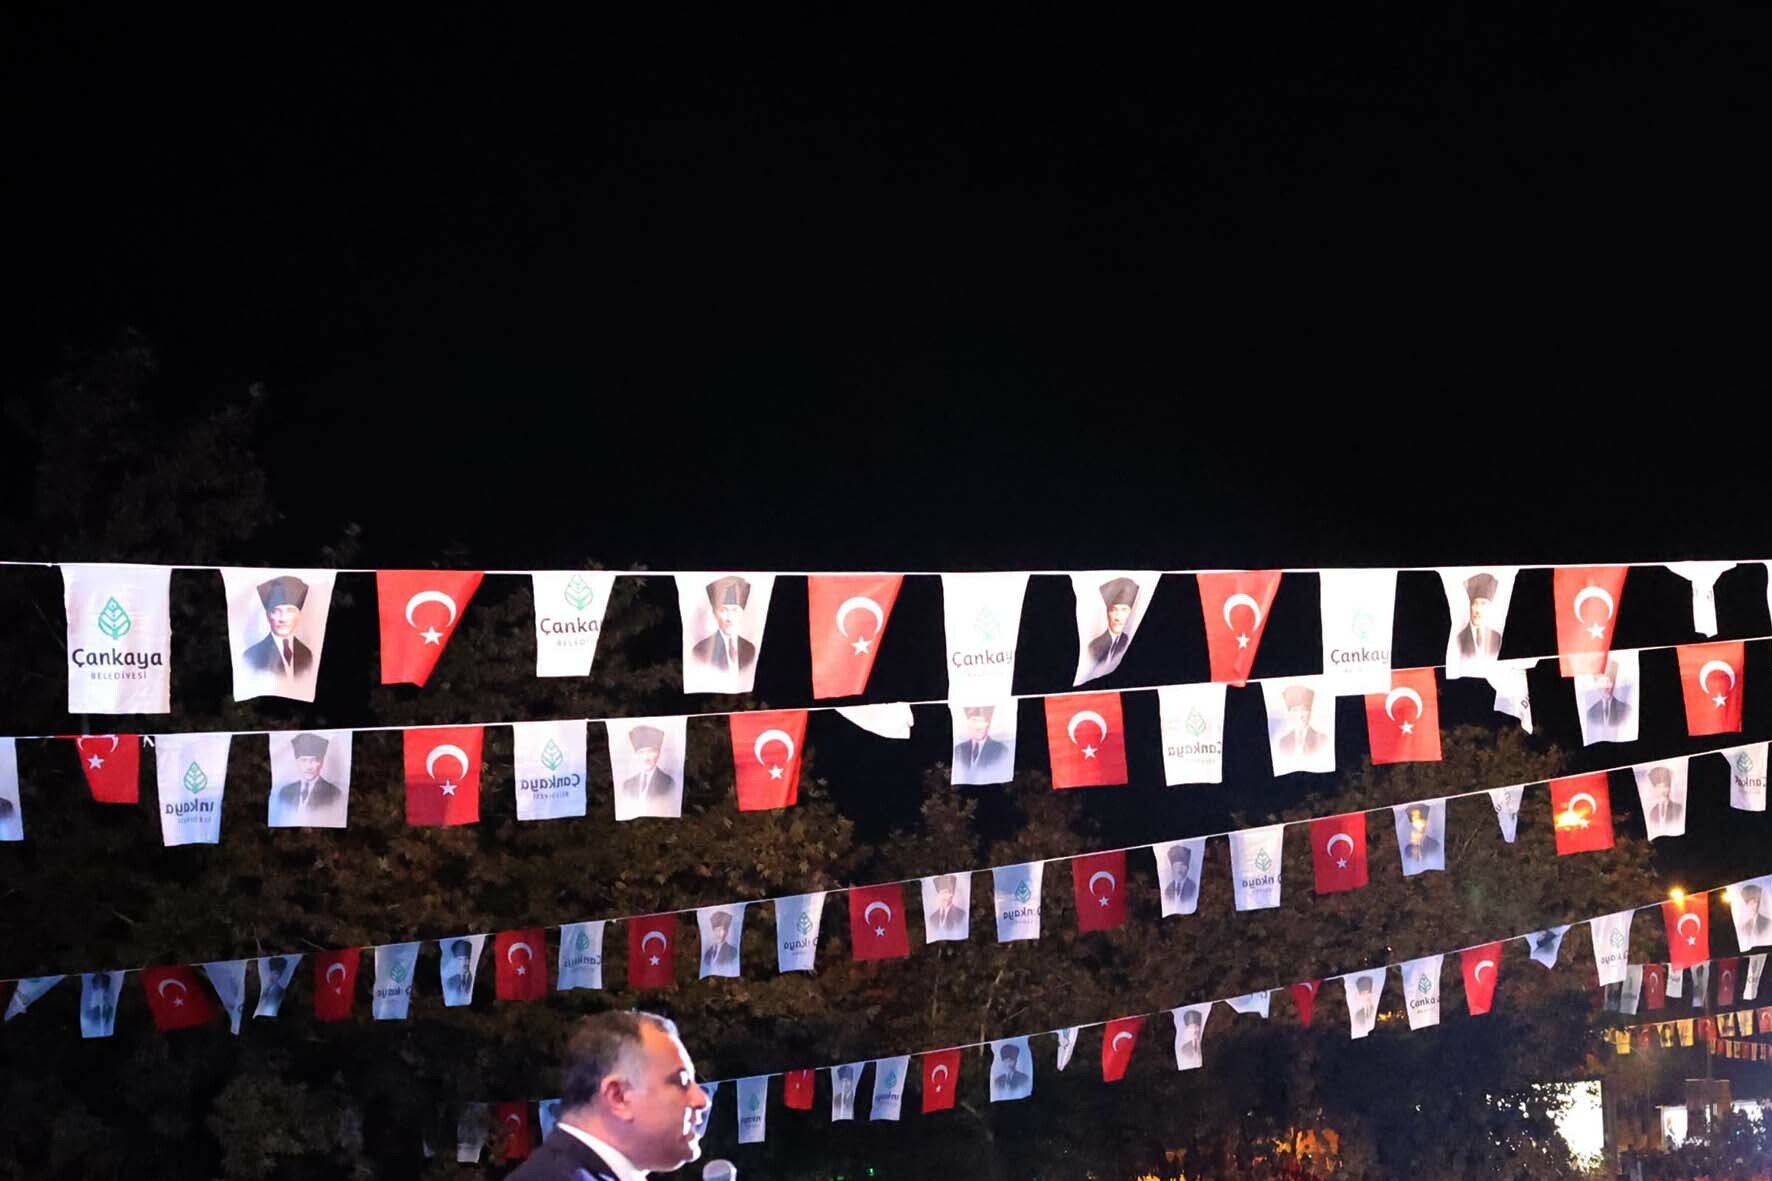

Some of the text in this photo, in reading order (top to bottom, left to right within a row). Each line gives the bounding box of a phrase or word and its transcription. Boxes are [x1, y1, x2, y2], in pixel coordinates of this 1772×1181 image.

[540, 617, 603, 635] Çanka
[72, 648, 163, 670] Çankaya
[1331, 648, 1389, 664] Çankay
